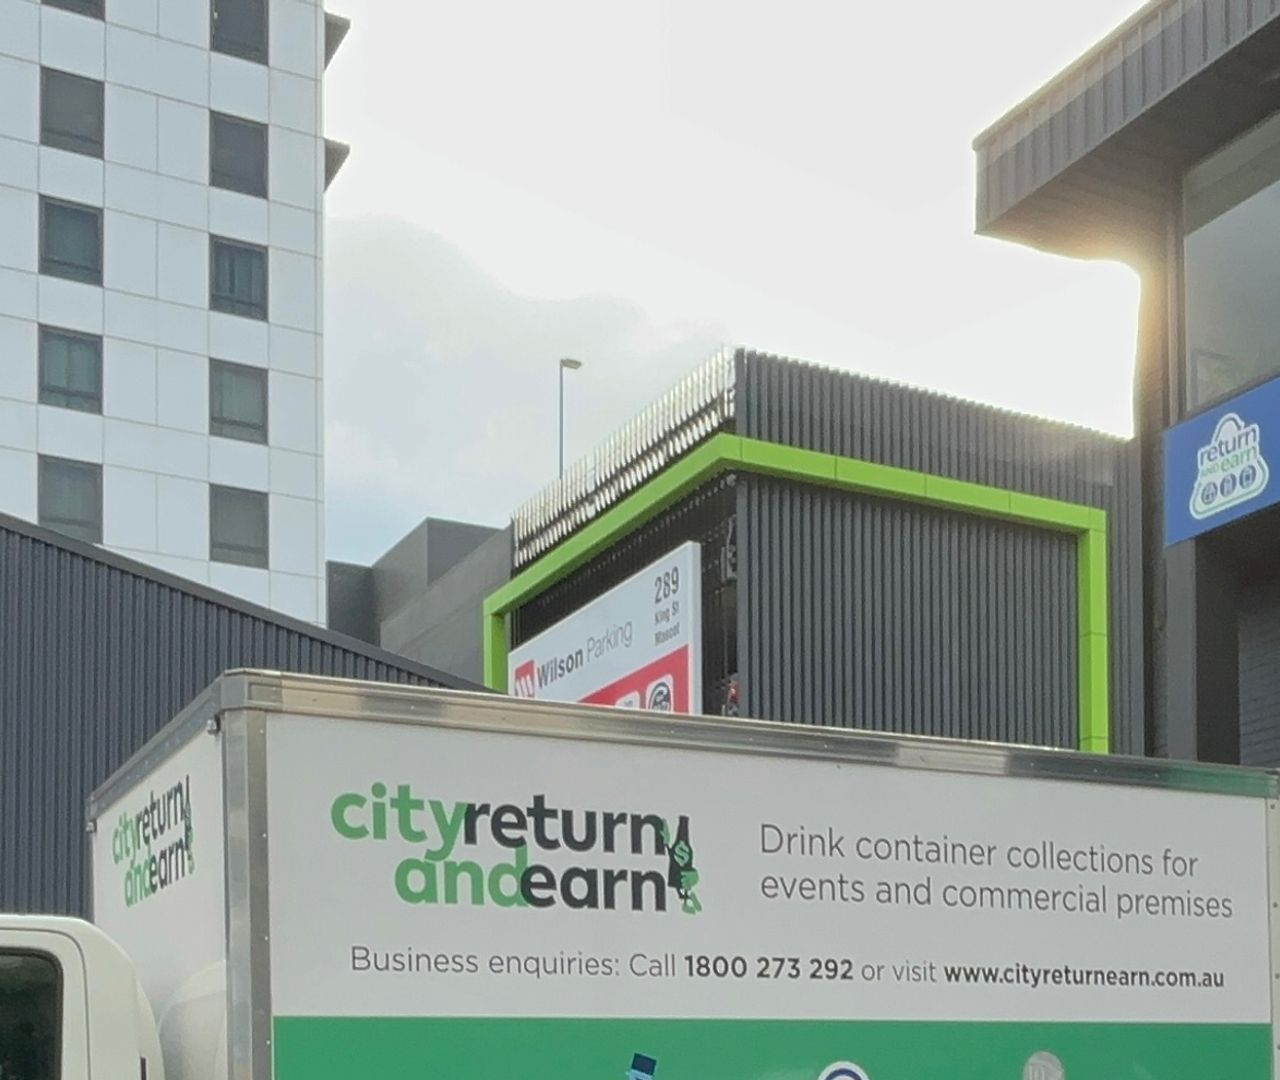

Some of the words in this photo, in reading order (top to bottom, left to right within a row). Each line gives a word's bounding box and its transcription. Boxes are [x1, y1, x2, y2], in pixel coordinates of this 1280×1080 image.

[1200, 428, 1257, 466] return
[1221, 446, 1257, 472] earn
[654, 566, 680, 604] 289
[654, 608, 670, 626] King
[537, 649, 584, 689] Wilson
[586, 621, 633, 663] Parking
[761, 824, 845, 858] Drink
[856, 834, 997, 866] container
[1007, 841, 1153, 875] collections
[1163, 848, 1198, 877] for
[760, 873, 865, 903] events
[876, 877, 931, 906] and
[942, 883, 1107, 914] commercial
[1116, 889, 1233, 919] premises
[351, 945, 478, 974] Business
[488, 949, 620, 979] enquiries:
[629, 954, 676, 978] Call
[684, 956, 746, 979] 1800
[756, 957, 801, 980] 273
[809, 959, 854, 981] 292
[861, 963, 884, 982] or
[892, 960, 937, 983] visit
[944, 963, 1225, 988] www.cityreturnearn.com.au
